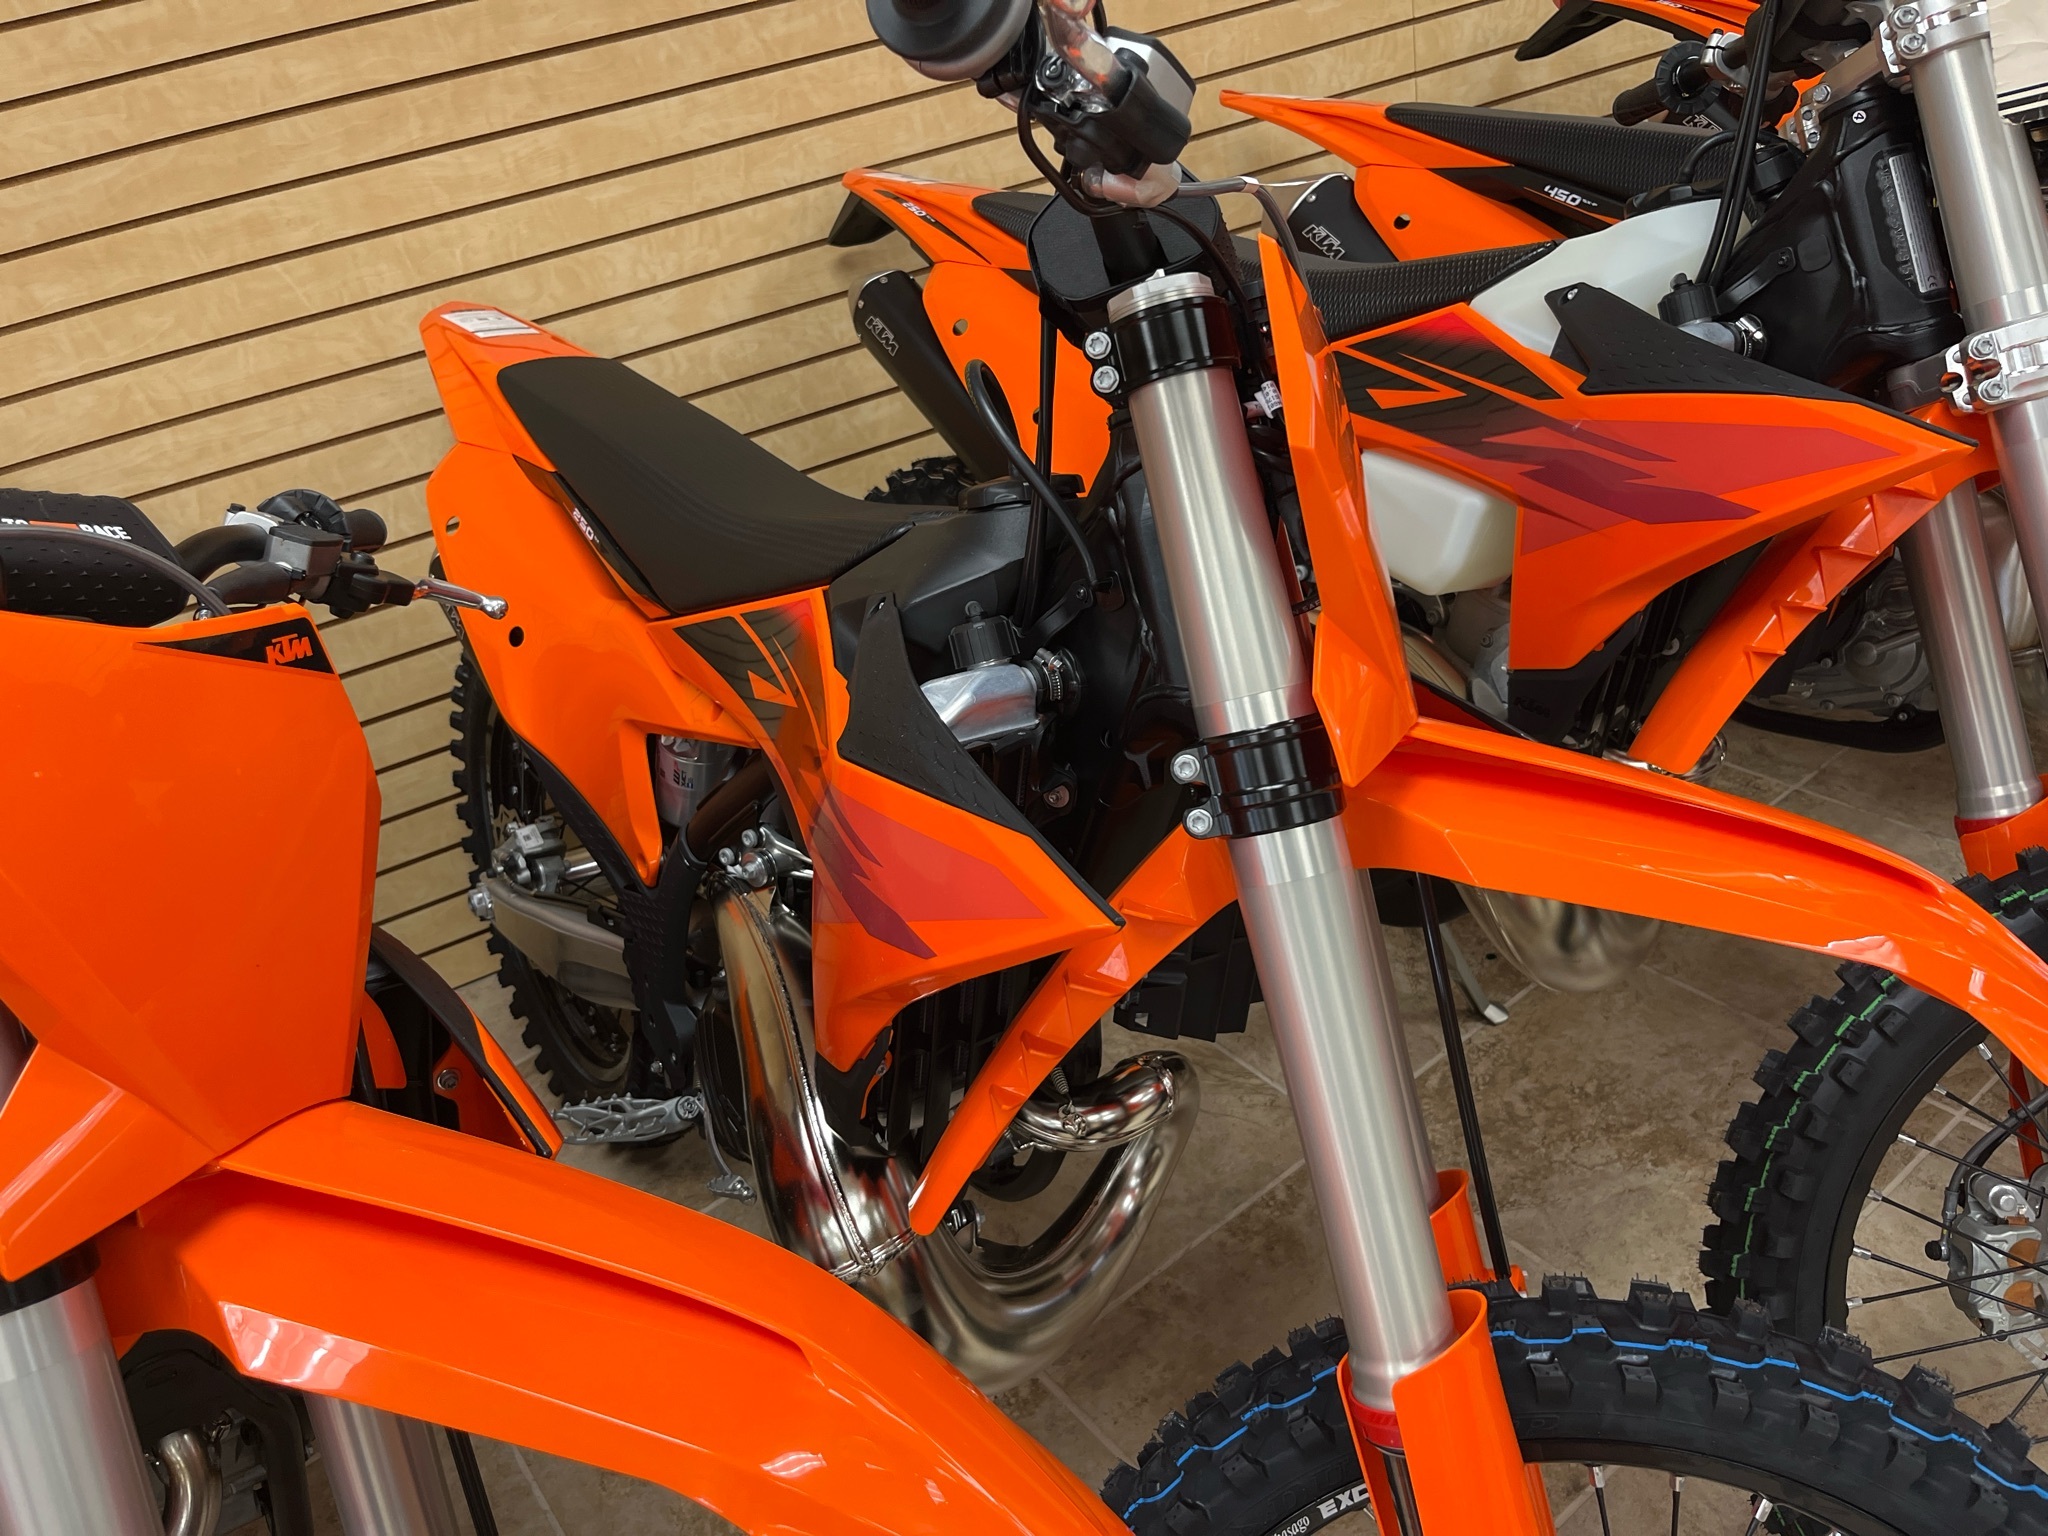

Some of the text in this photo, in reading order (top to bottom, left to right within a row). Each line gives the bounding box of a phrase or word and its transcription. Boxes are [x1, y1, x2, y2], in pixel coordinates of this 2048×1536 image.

[1543, 185, 1582, 206] 450
[1301, 224, 1346, 260] KTM
[864, 315, 899, 357] KTM
[573, 507, 594, 541] 250
[265, 633, 313, 666] KTM
